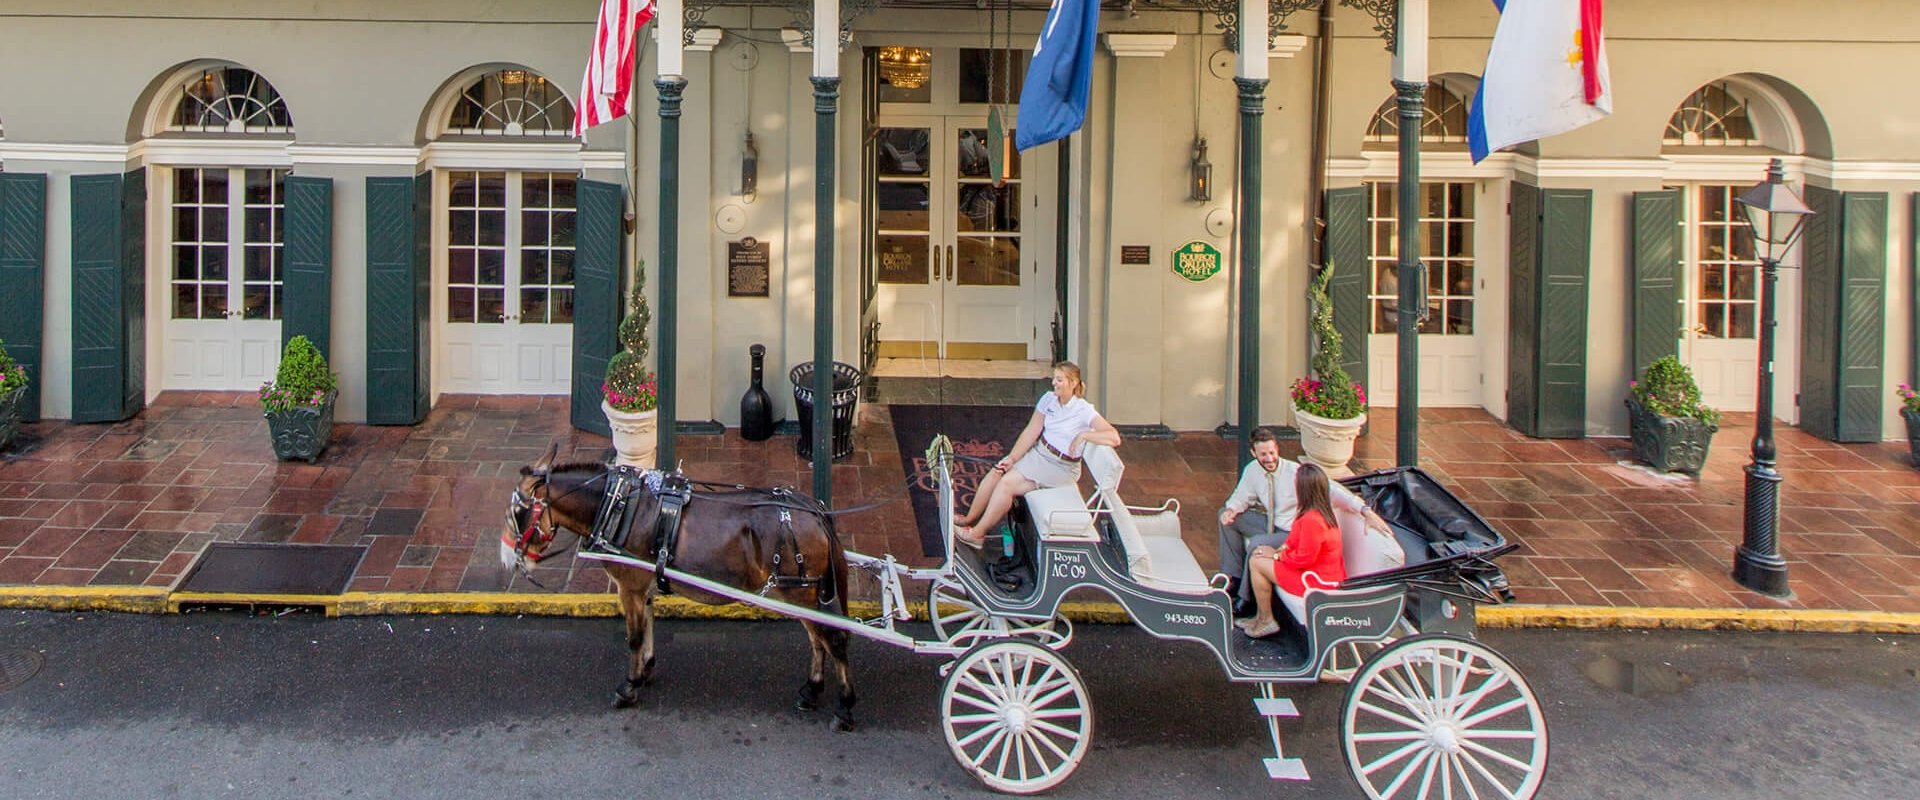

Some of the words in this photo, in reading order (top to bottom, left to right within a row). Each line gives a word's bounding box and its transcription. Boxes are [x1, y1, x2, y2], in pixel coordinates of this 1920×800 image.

[1180, 253, 1216, 261] BOURBON
[1179, 260, 1216, 268] ORLEANS
[1182, 267, 1212, 276] HOTEL
[1054, 552, 1080, 564] Royal
[1052, 564, 1068, 577] AC
[1071, 565, 1086, 579] 09
[1164, 613, 1206, 625] 943-8820
